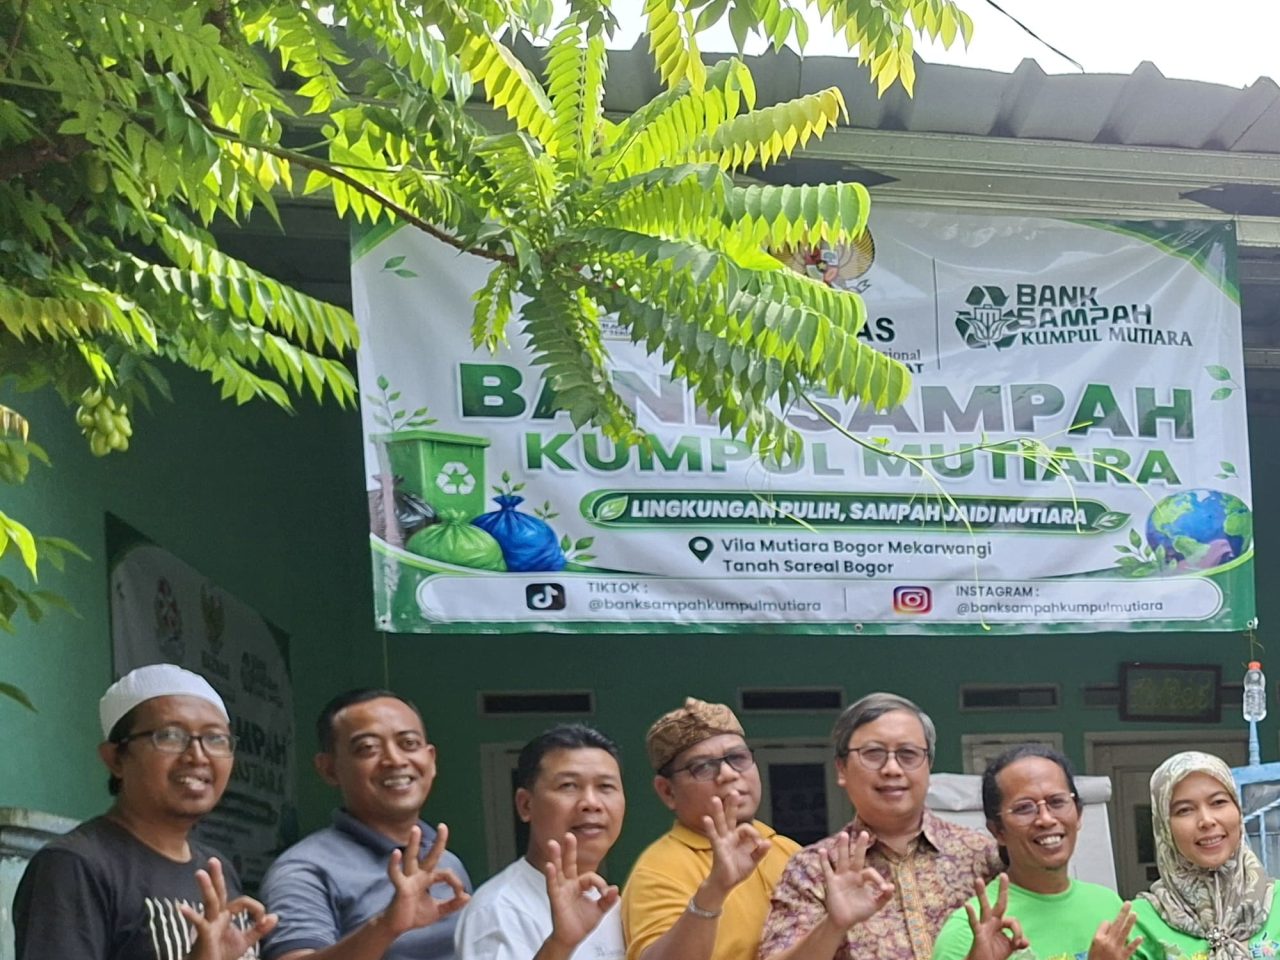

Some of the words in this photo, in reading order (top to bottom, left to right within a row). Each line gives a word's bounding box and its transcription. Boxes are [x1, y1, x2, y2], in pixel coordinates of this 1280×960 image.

[1016, 283, 1100, 308] BANK
[1017, 304, 1152, 329] SAMPAH
[1021, 328, 1103, 346] KUMPUL
[1109, 327, 1193, 347] MUTIARA
[862, 442, 1182, 485] MUTIARA
[631, 499, 776, 519] LINGKUNGAN
[780, 501, 847, 522] PULIH,
[850, 503, 941, 522] SAMPAH
[943, 505, 997, 523] JAIDI
[998, 506, 1087, 525] MUTIARA
[721, 538, 755, 552] Vila
[761, 539, 830, 553] Mutiara
[834, 539, 884, 557] Bogor
[888, 541, 992, 559] Mekarwangi
[723, 560, 780, 573] Tanah
[784, 560, 840, 574] Sareal
[844, 560, 894, 577] Bogor
[587, 582, 641, 594] TIKTOK
[955, 585, 1031, 598] INSTAGRAM
[588, 599, 822, 613] @banksampahkumpulmutiara
[956, 601, 1163, 616] @banksampahkumpulmutiara
